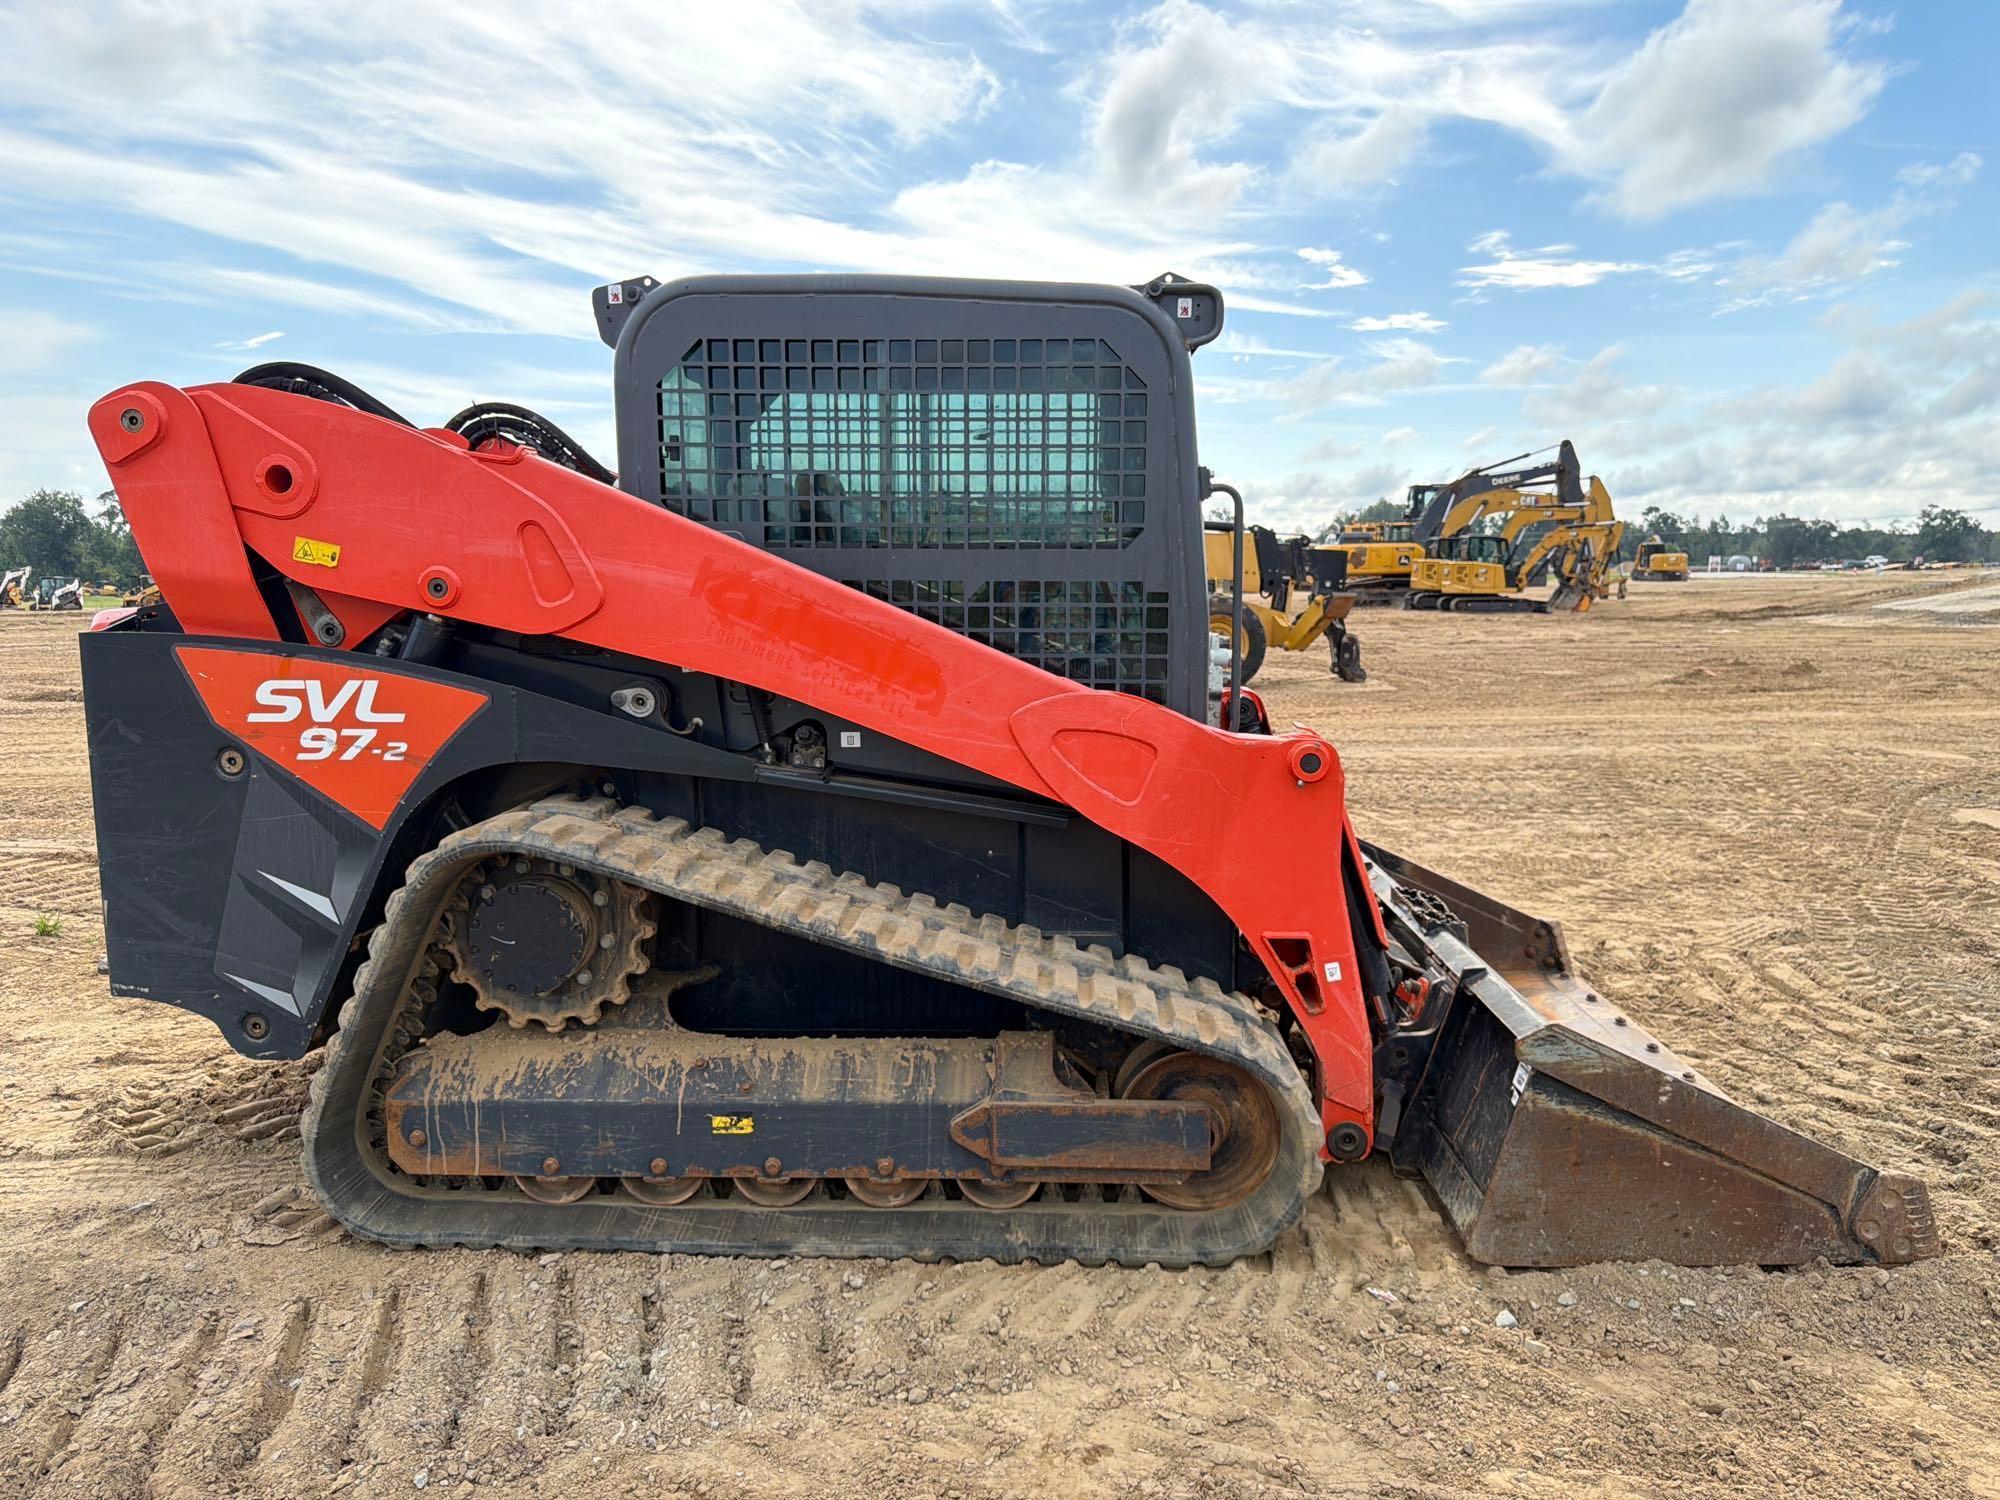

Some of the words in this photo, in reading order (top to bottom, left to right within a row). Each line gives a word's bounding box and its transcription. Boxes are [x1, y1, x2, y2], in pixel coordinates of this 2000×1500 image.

[1491, 474, 1520, 486] DEERE
[1520, 495, 1536, 507] CAT
[246, 679, 406, 723] SVL
[296, 727, 408, 761] 97-2
